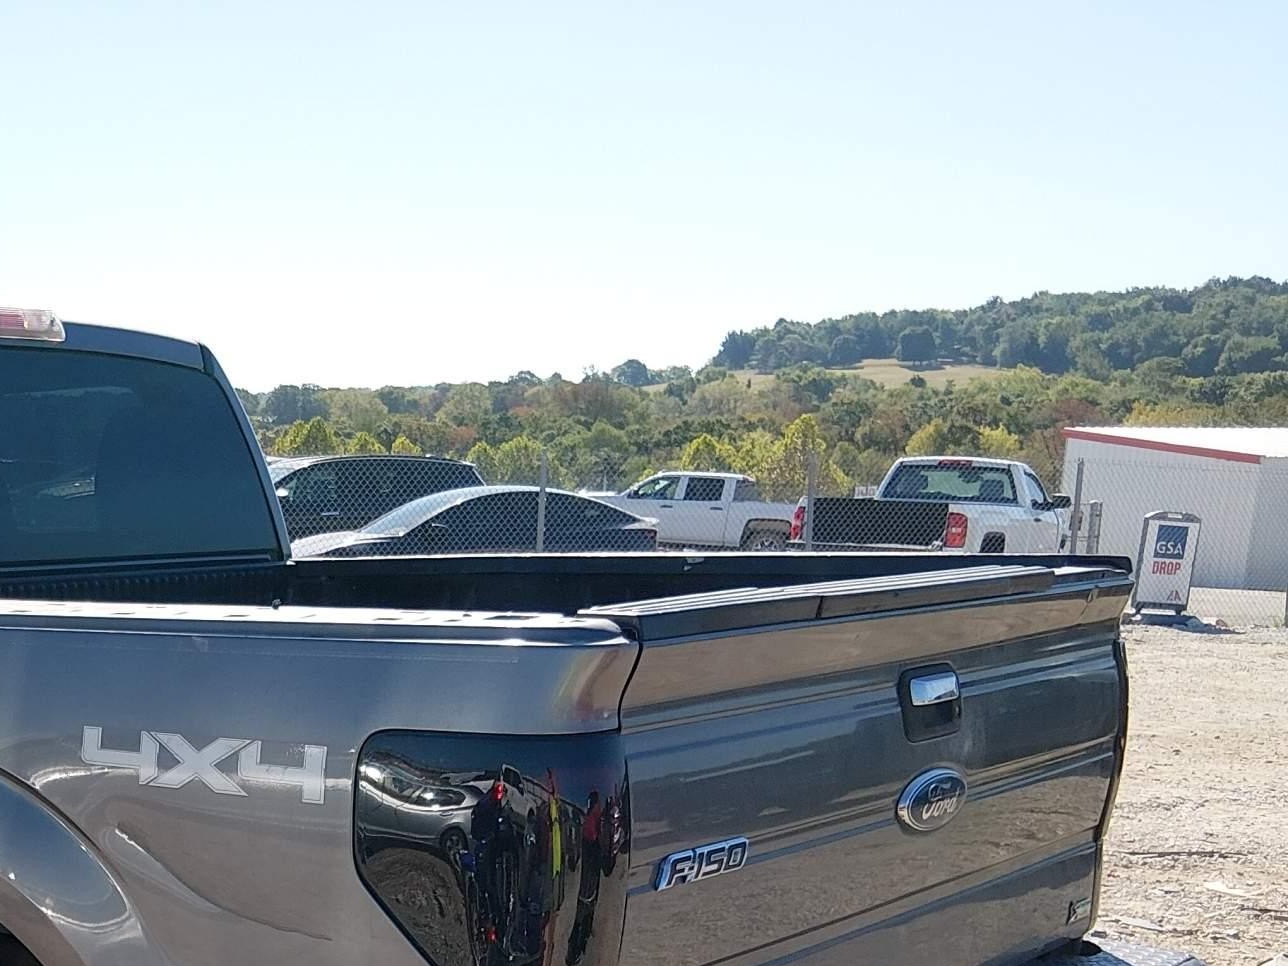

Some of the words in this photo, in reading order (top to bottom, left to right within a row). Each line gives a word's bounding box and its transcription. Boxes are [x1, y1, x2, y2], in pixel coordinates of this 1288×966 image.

[1156, 541, 1183, 555] GSA
[1152, 560, 1182, 575] DROP
[921, 781, 961, 820] Ford
